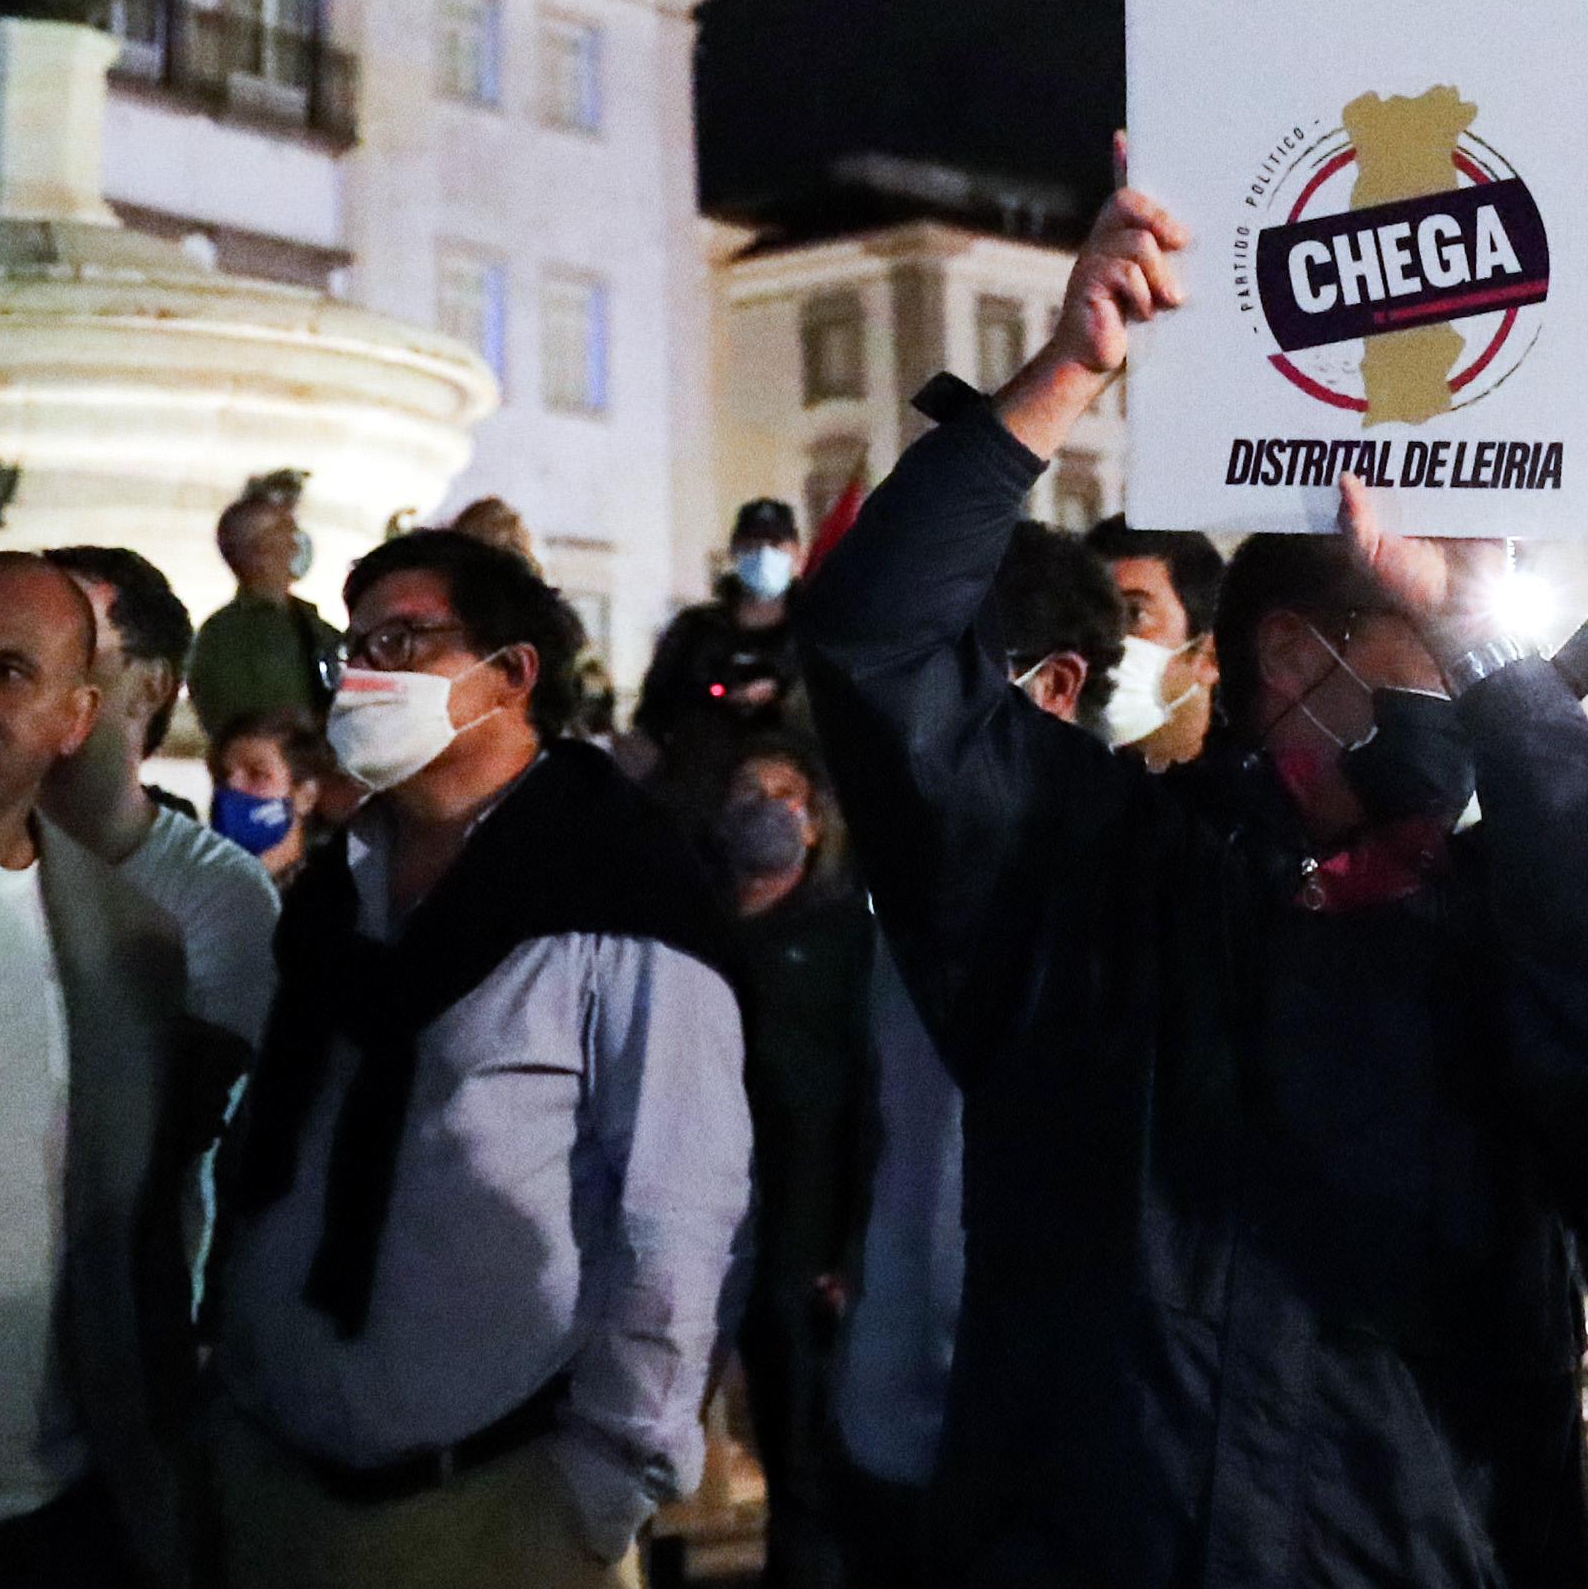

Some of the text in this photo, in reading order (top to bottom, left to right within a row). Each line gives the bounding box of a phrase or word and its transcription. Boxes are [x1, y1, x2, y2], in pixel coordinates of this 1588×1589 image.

[1234, 226, 1254, 312] PARTIDO
[1288, 204, 1522, 314] CHEGA
[1225, 438, 1564, 490] DISTRITAL DE LEIRIA
